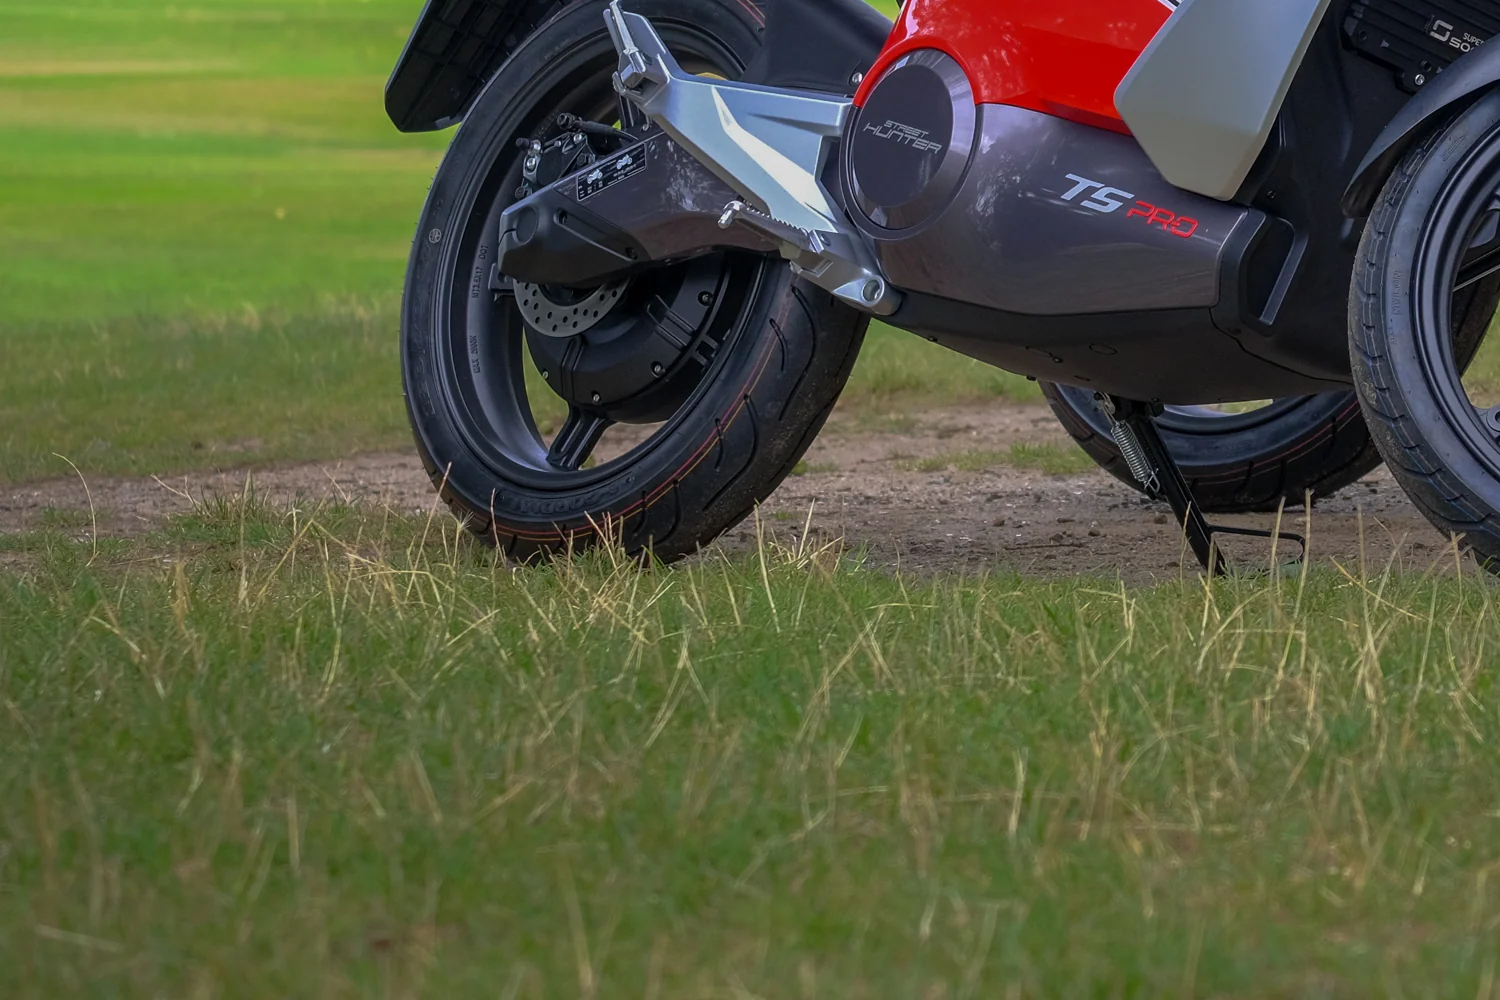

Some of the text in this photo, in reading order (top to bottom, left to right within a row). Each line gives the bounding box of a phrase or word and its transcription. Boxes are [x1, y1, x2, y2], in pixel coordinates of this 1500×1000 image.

[862, 122, 942, 155] HUNTER
[882, 118, 930, 138] STREET
[1060, 172, 1199, 239] TS PRO
